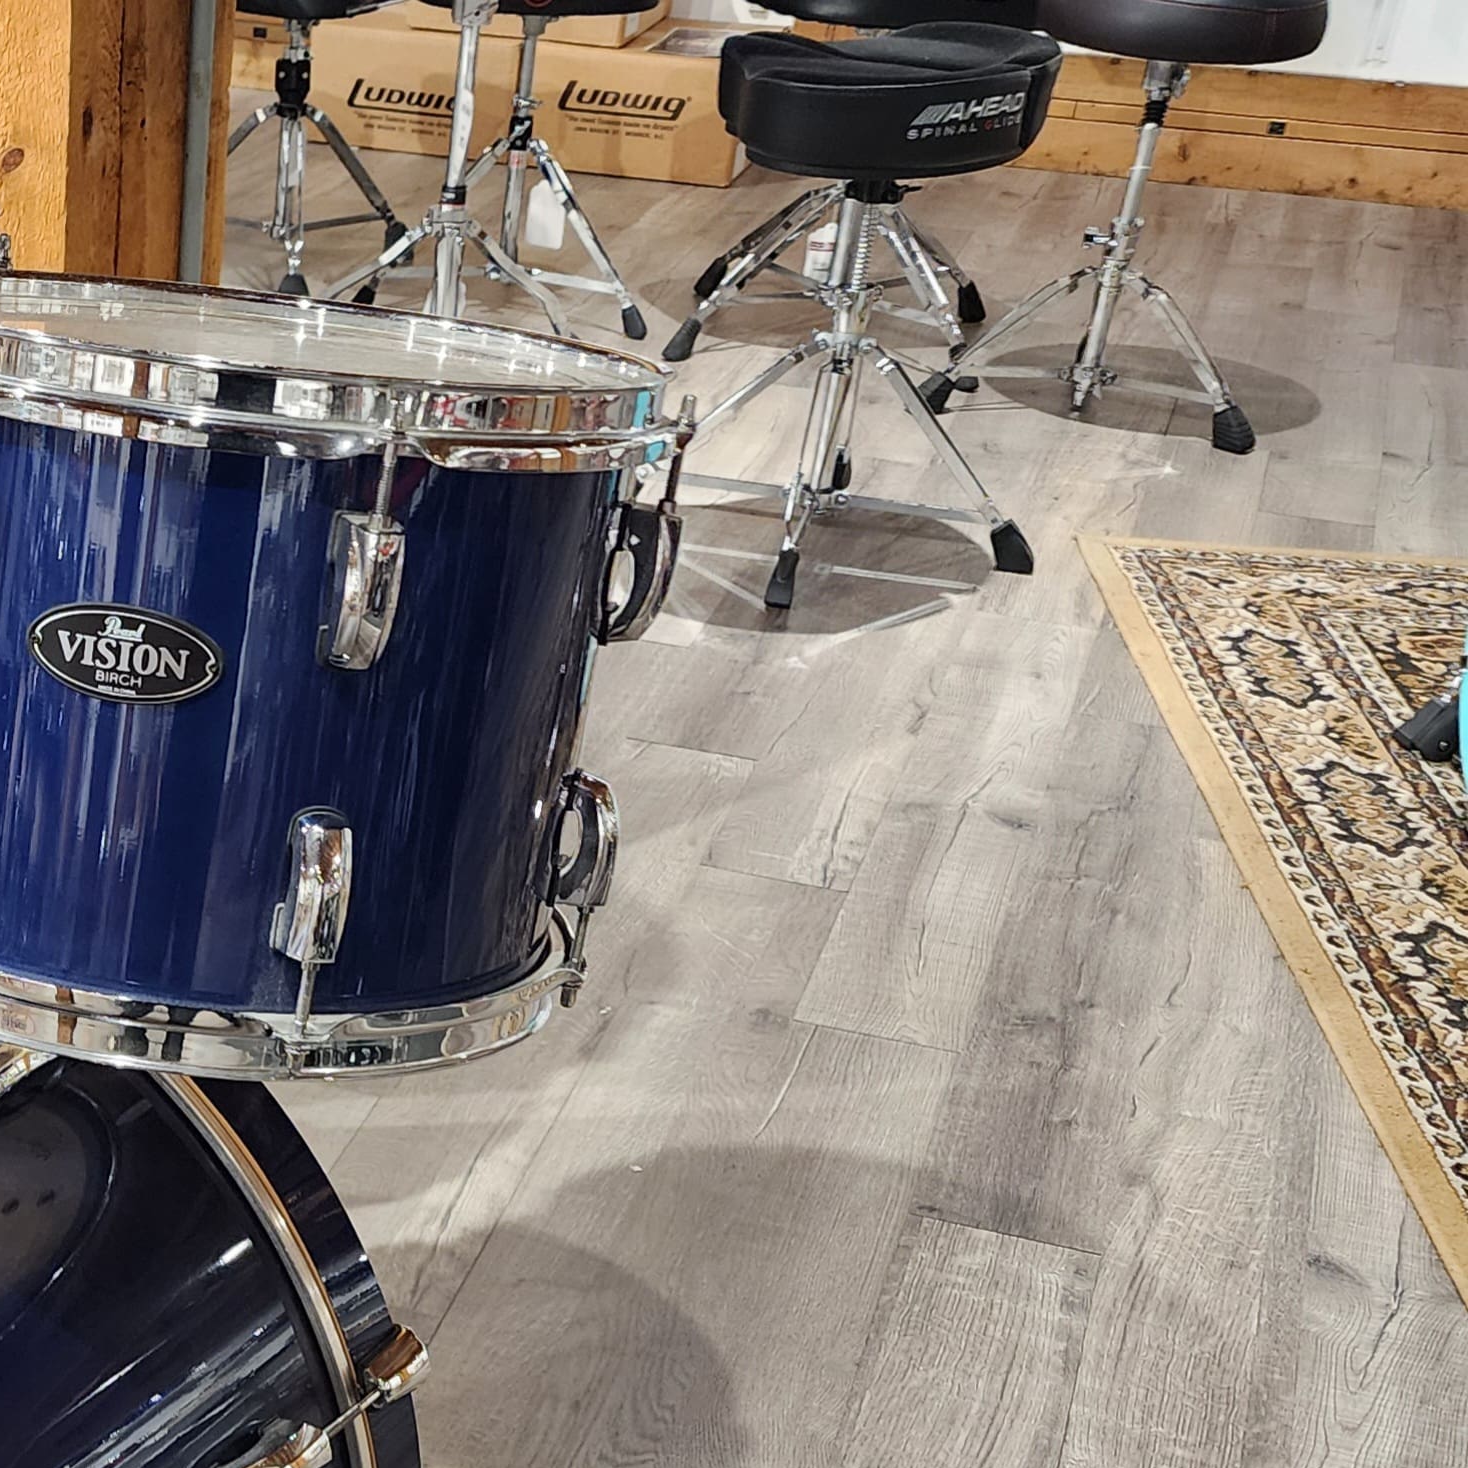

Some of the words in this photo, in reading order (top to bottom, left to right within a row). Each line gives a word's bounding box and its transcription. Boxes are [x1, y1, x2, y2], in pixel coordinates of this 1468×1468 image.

[942, 92, 1025, 123] AHEAD
[906, 123, 978, 139] SPINAL
[97, 616, 146, 642] Pearl
[57, 629, 190, 681] VISION
[94, 670, 142, 688] BIRCH
